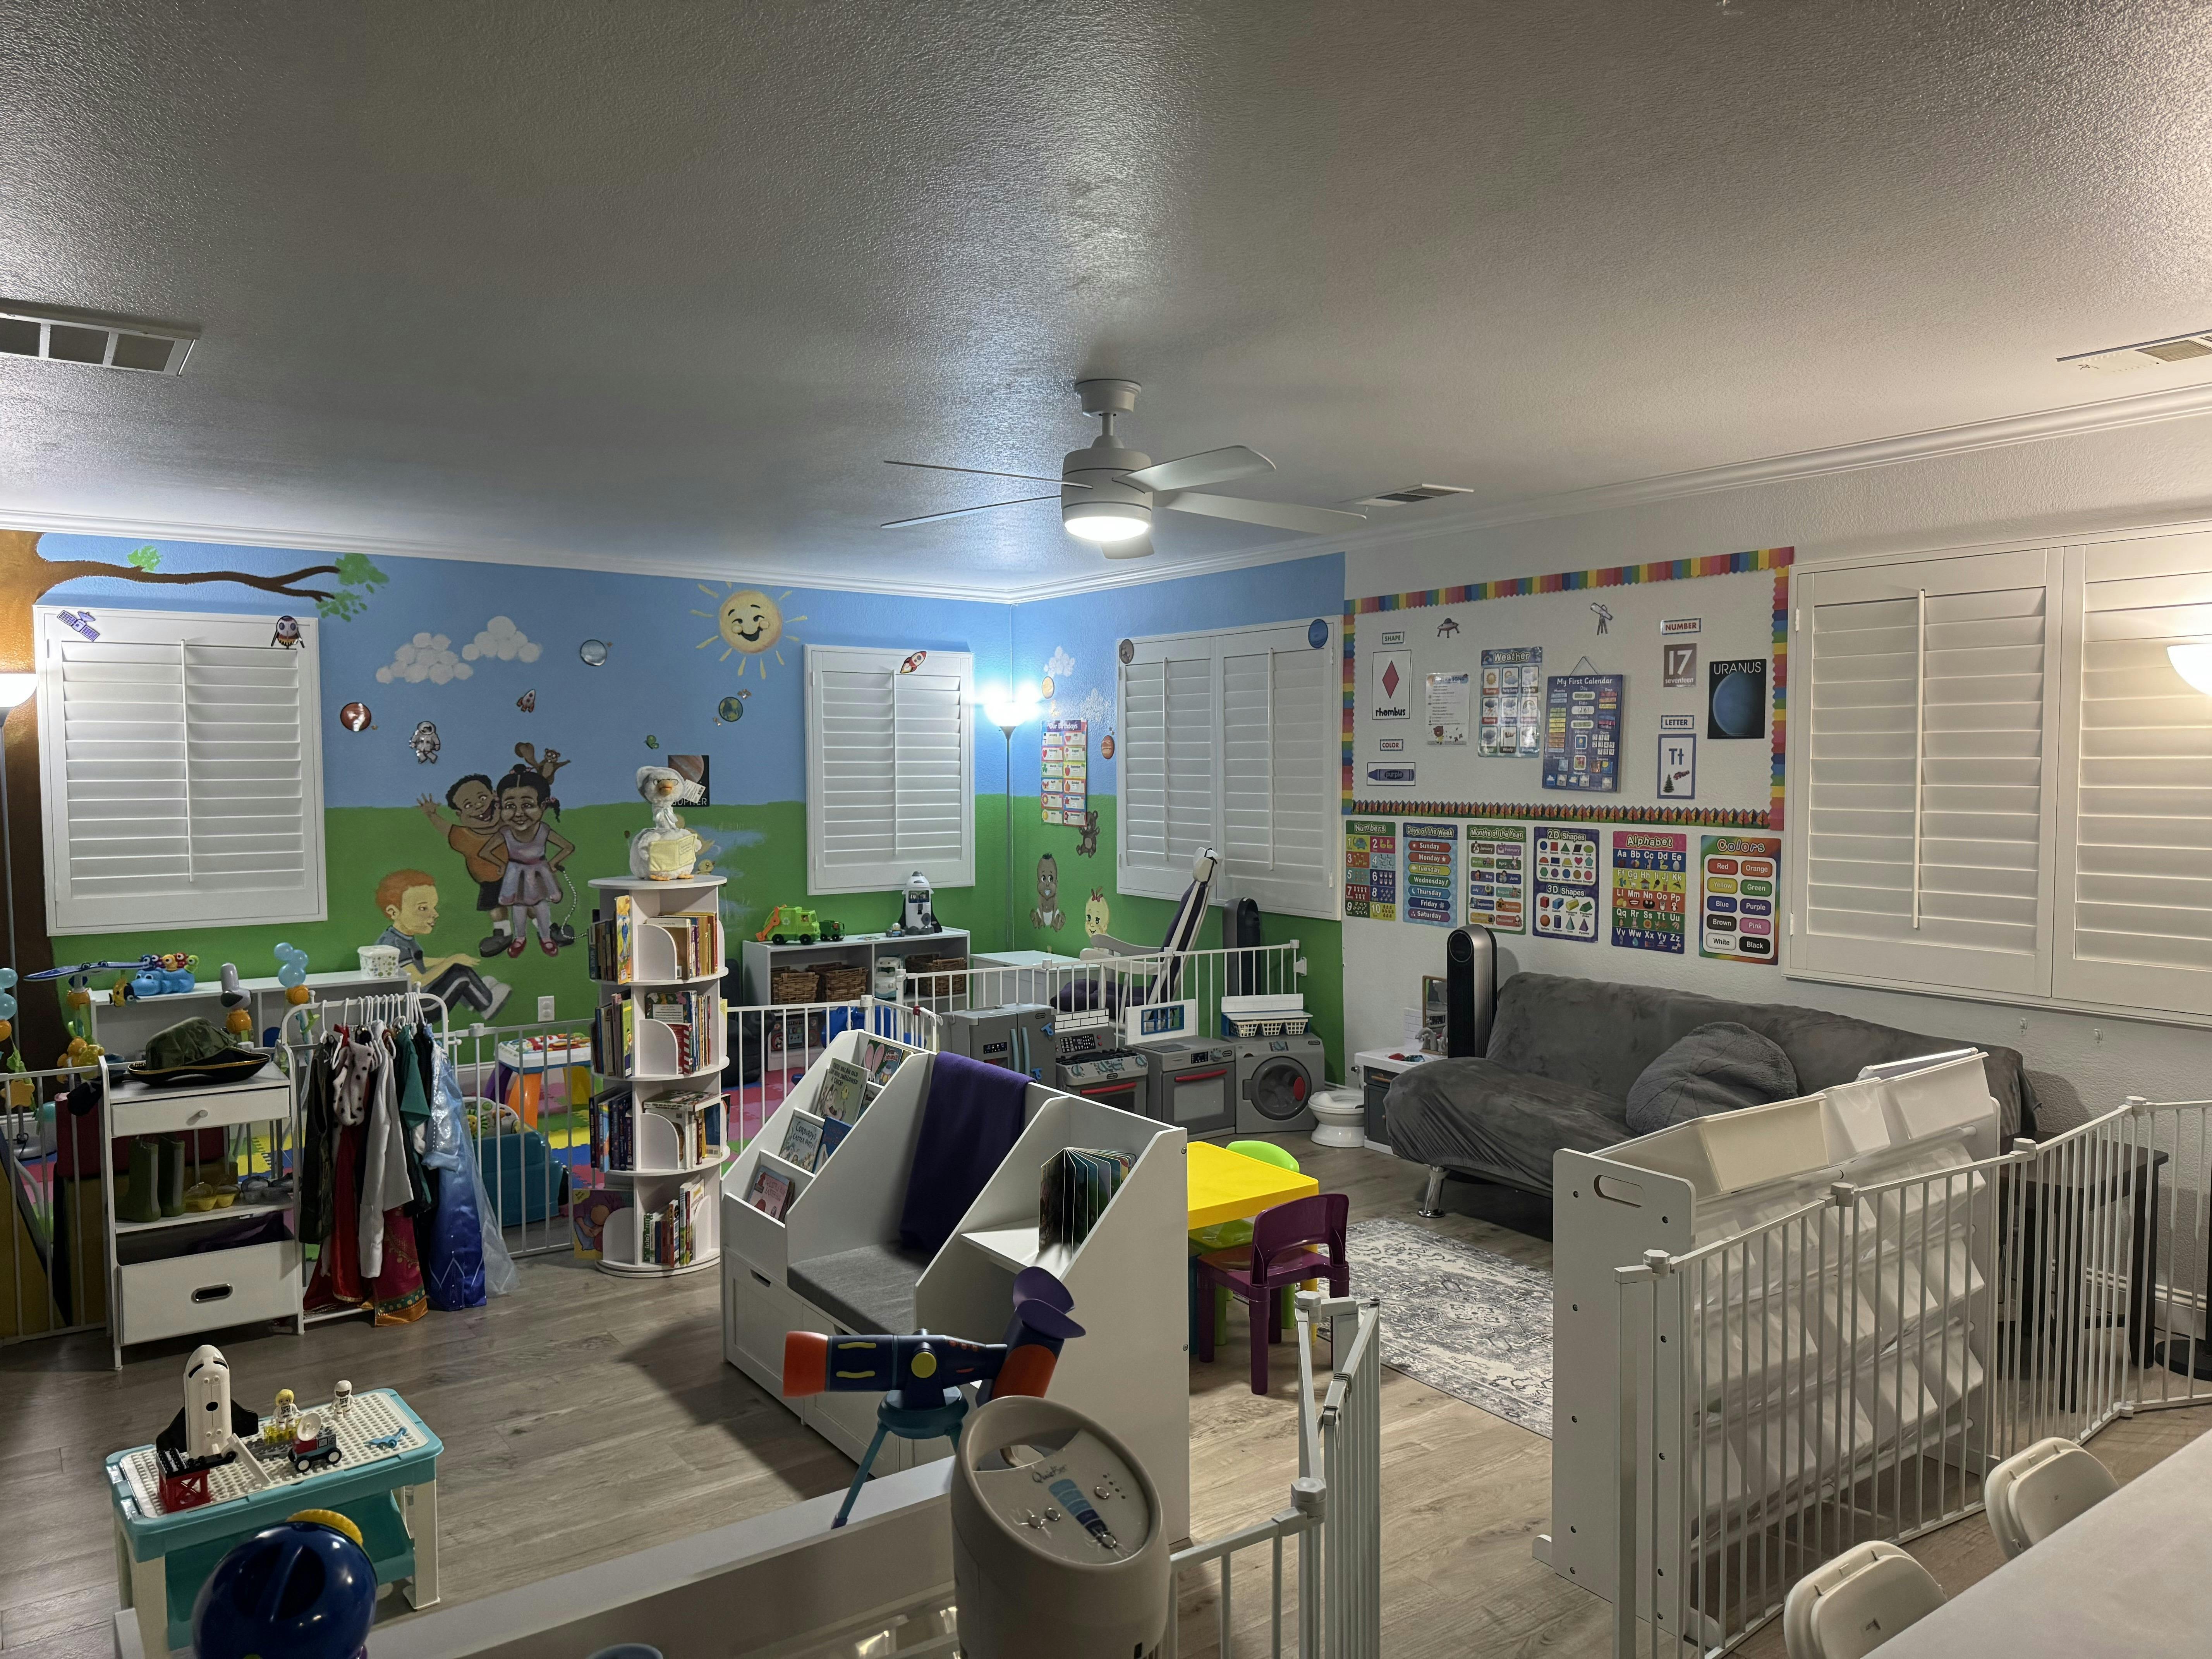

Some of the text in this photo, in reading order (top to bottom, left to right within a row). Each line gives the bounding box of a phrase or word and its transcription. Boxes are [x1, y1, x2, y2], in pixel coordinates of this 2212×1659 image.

[1665, 622, 1697, 630] NUMBER
[1494, 651, 1530, 662] Weather
[1668, 649, 1693, 675] 17
[1714, 662, 1761, 675] URANUS
[1557, 678, 1566, 687] My
[1376, 707, 1406, 716] rhombus
[1668, 748, 1684, 765] Tt
[1355, 824, 1385, 832] Numbers
[1407, 826, 1420, 835] Days
[1547, 830, 1585, 842] 2D Shapes
[1627, 835, 1672, 847] Alphabet
[1348, 838, 1378, 848] 1 2
[1419, 842, 1440, 851] Sunday
[1717, 838, 1765, 852] Colors
[1347, 854, 1377, 865] 3 4
[1419, 854, 1440, 862] Monday
[1630, 850, 1640, 858] Bb
[1672, 853, 1681, 861] Ee
[1746, 865, 1768, 873] Orange
[1347, 870, 1377, 881] 5 6
[1414, 876, 1445, 886] Wednesday
[1628, 870, 1637, 879] Gg
[1662, 873, 1668, 881] Jj
[1347, 886, 1377, 897] 7 8
[1417, 888, 1441, 897] Thursday
[1547, 885, 1584, 897] 3D Shapes
[1657, 892, 1667, 900] Oo
[1671, 893, 1680, 902] Pp
[1347, 902, 1380, 914] 9 10
[1420, 900, 1437, 908] Friday
[1746, 903, 1766, 911] Purple
[1417, 911, 1441, 920] Saturday
[1616, 908, 1626, 918] Qq
[1644, 911, 1652, 919] Ss
[1670, 914, 1680, 922] Uu
[1616, 928, 1680, 942] Vv Ww Xx Yy Zz
